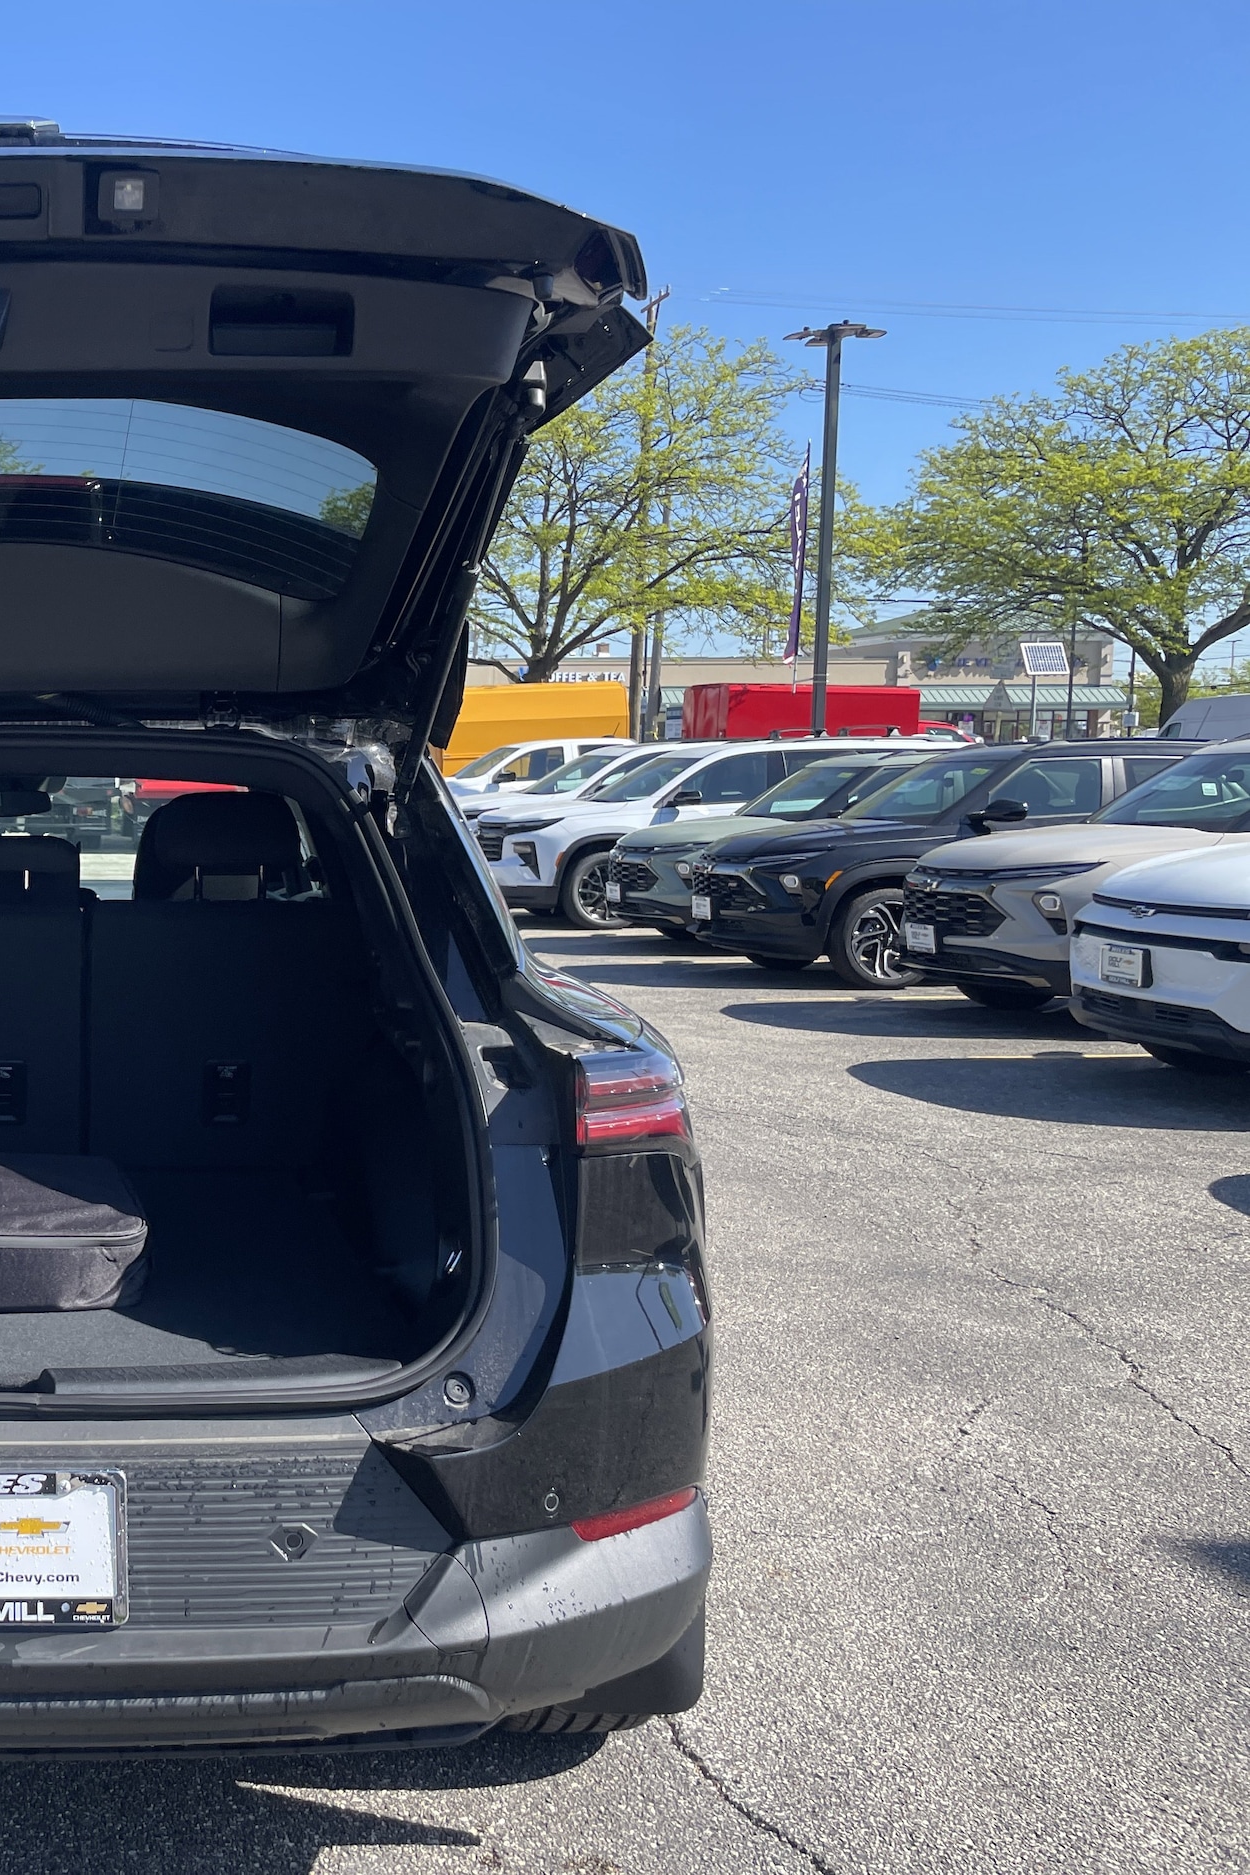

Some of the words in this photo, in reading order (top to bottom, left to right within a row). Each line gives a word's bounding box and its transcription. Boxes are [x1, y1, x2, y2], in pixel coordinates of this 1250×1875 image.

[548, 671, 583, 682] OFFEE
[587, 672, 598, 682] &
[603, 672, 627, 682] TEA
